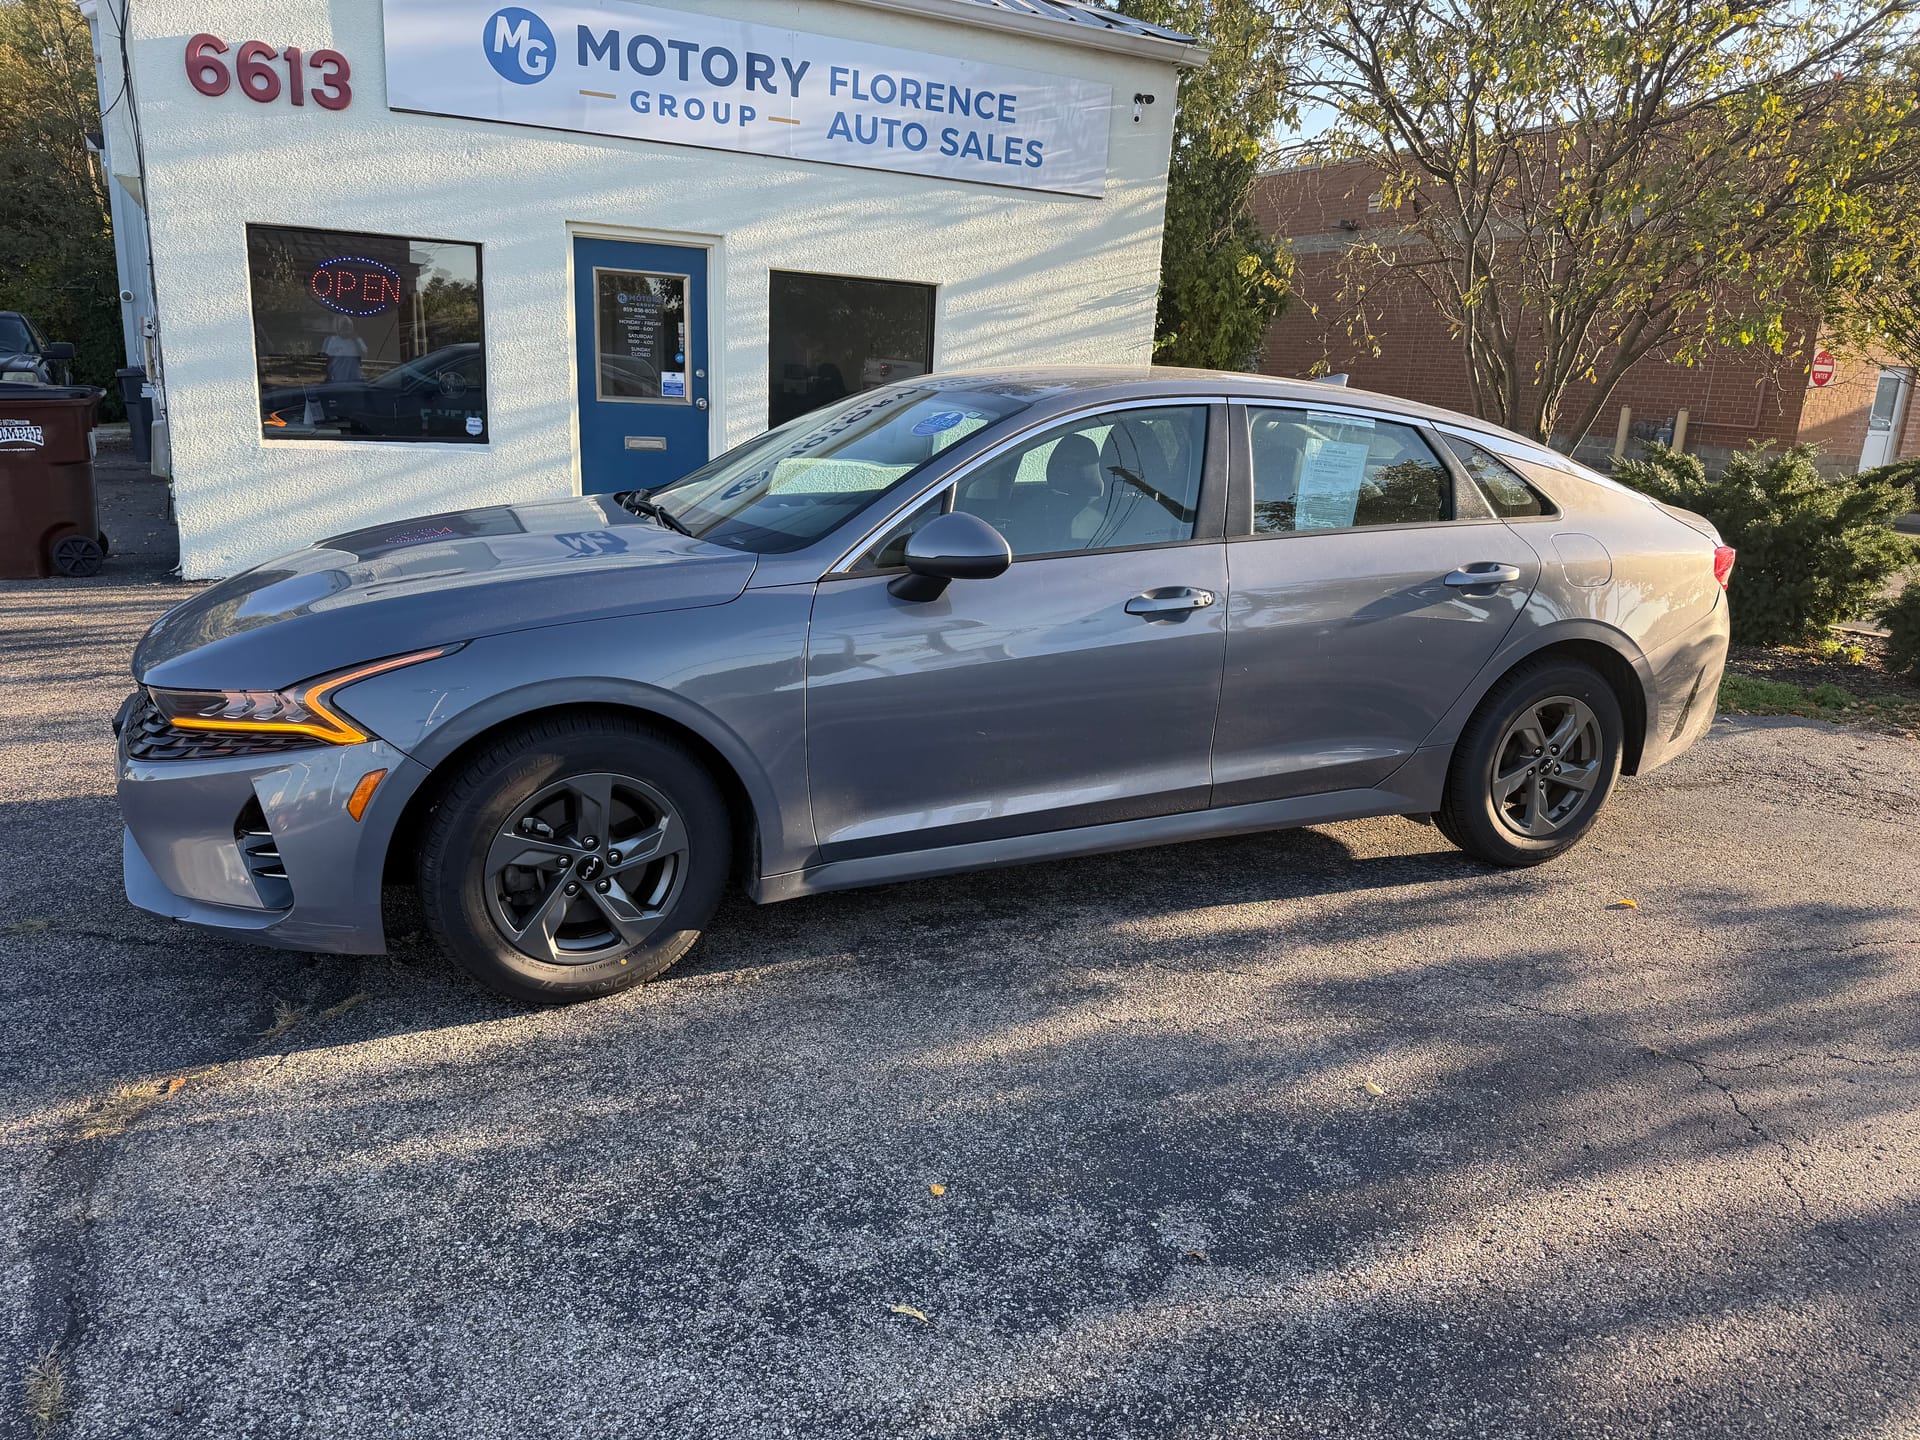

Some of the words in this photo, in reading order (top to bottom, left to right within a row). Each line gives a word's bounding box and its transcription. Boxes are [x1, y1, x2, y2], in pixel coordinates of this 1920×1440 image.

[185, 33, 352, 111] 6613
[493, 15, 548, 76] MG
[577, 24, 811, 98] MOTORY
[629, 90, 757, 127] GROUP
[829, 65, 1017, 124] FLORENCE
[826, 111, 928, 152] AUTO
[939, 127, 1044, 168] SALES
[311, 269, 401, 304] OPEN
